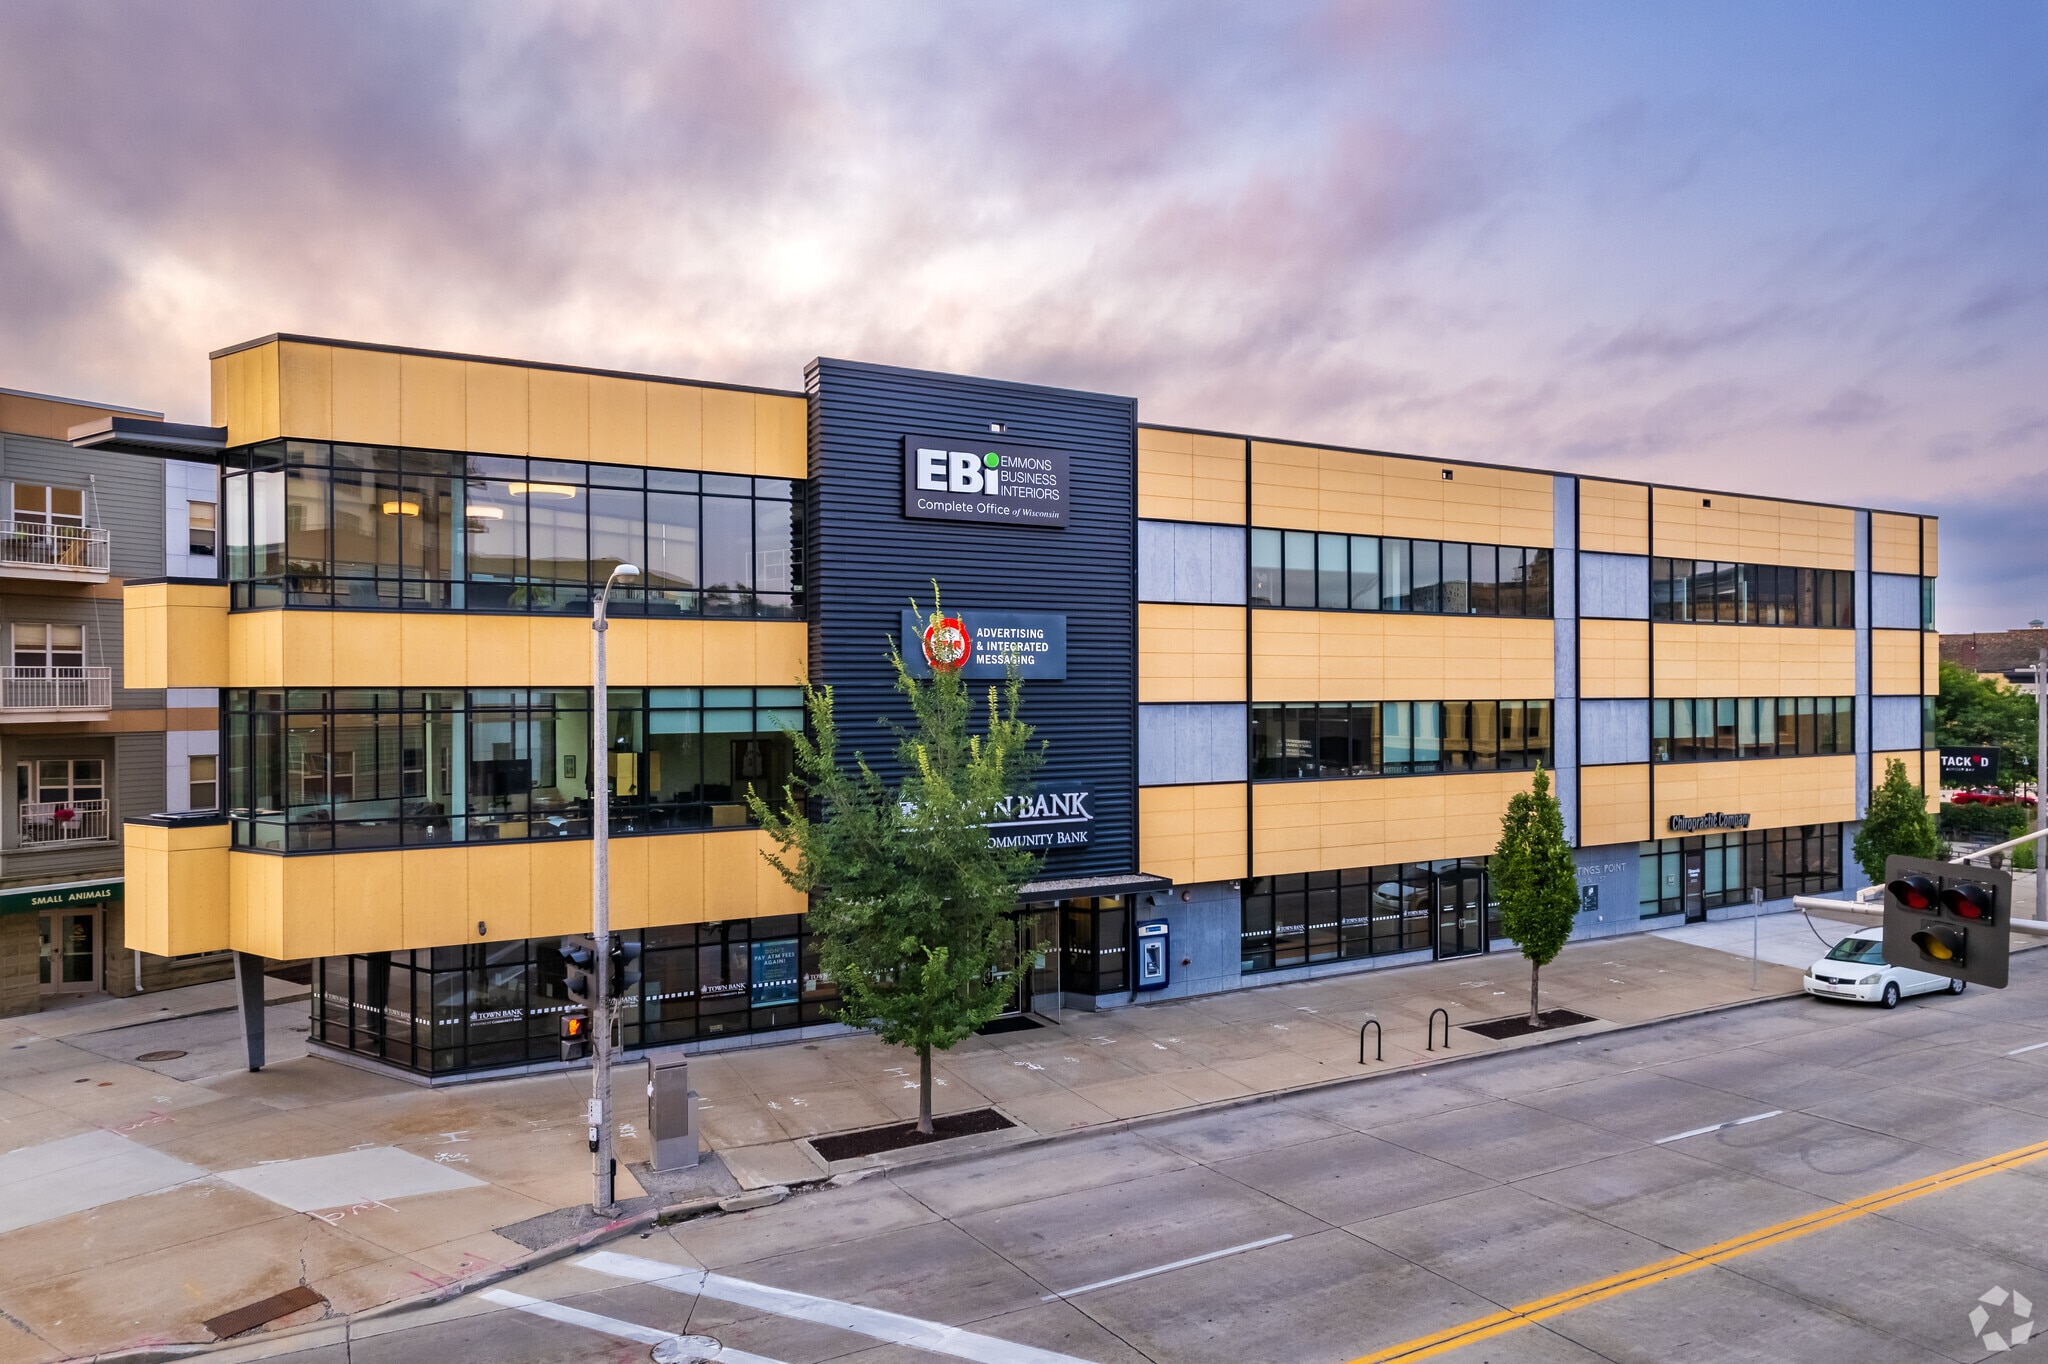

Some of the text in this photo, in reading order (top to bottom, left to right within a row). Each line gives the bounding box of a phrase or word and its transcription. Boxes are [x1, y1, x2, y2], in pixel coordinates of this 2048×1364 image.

[1001, 456, 1052, 471] EMMONS
[1001, 471, 1057, 486] BUSINESS
[1001, 485, 1060, 501] INTERIORS
[917, 499, 1060, 519] Complete Office of Wisconsin
[976, 627, 1044, 639] ADVERTISING
[976, 641, 1049, 652] & INTEGRATED
[976, 654, 1035, 665] MESSAGING
[1018, 792, 1094, 819] BANK
[1671, 812, 1750, 832] Chiropractic Company
[984, 831, 1088, 849] OMMUNITY BANK
[1577, 862, 1626, 876] TINGS POINT
[31, 889, 111, 906] SMALL ANIMALS
[707, 982, 746, 992] TOWN BANK
[478, 1008, 523, 1019] TOWN BANK
